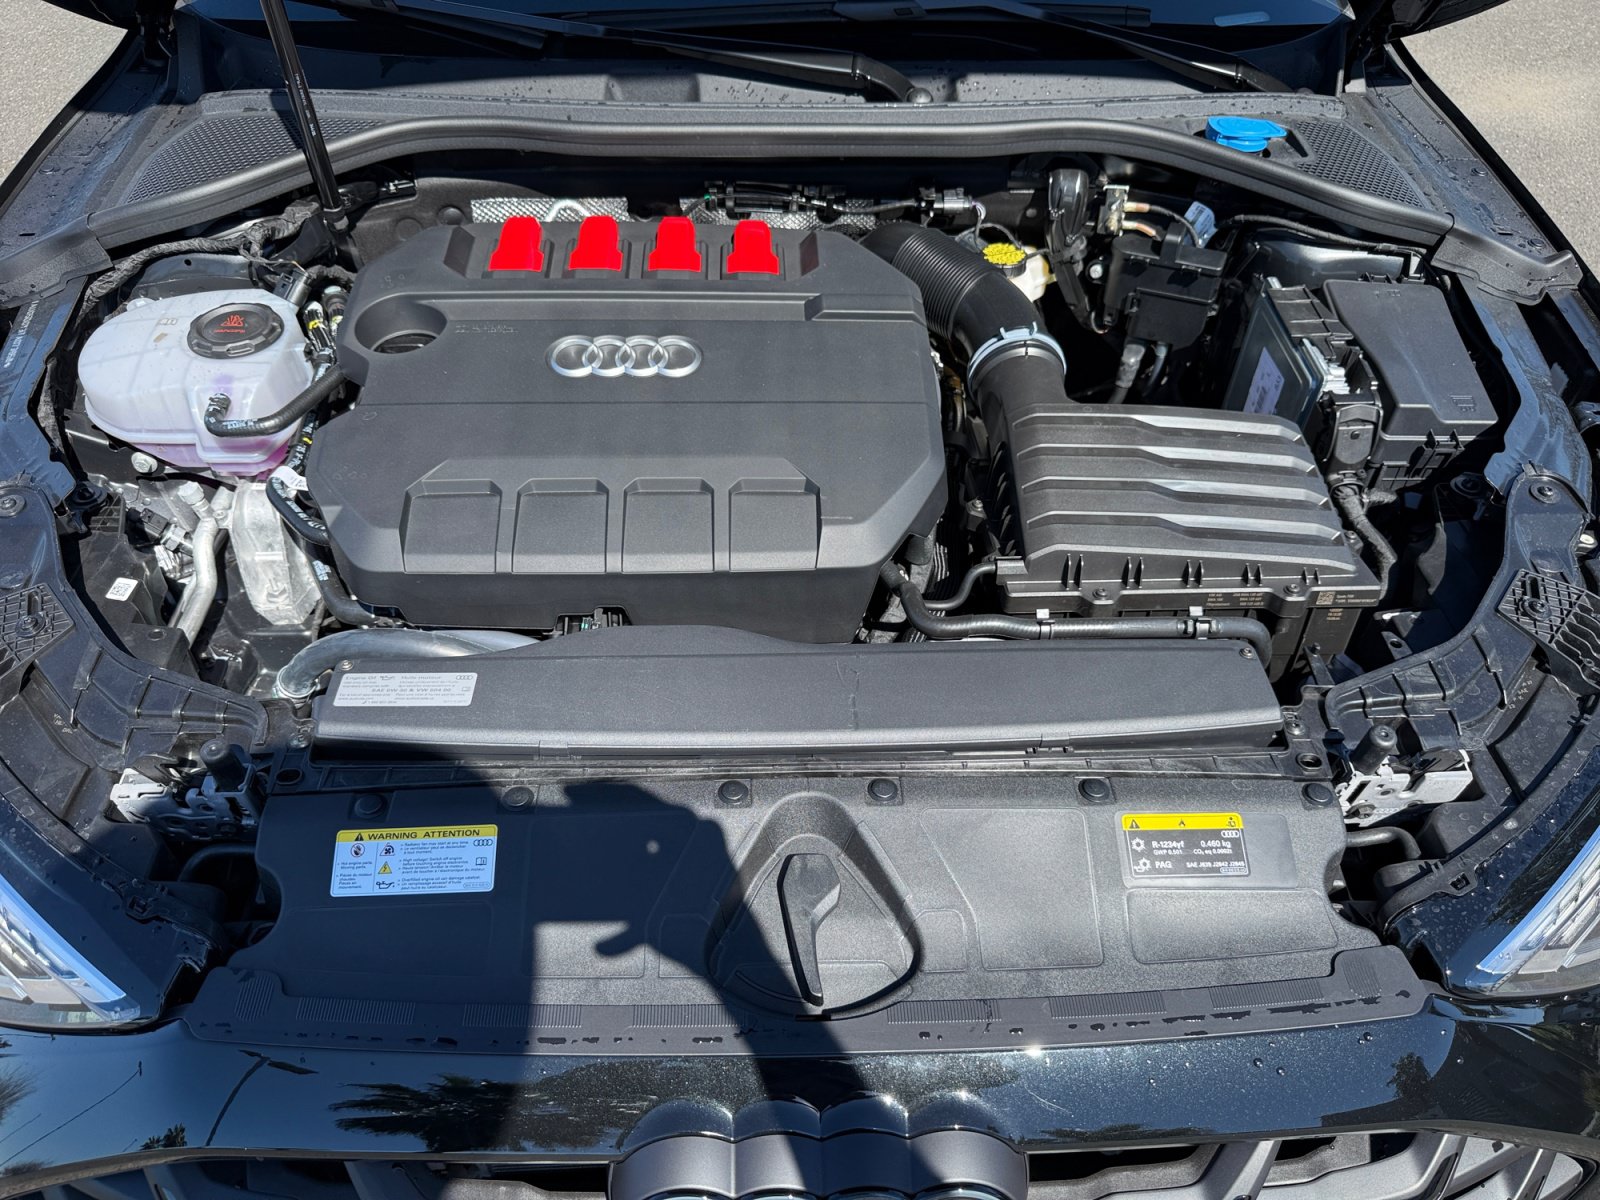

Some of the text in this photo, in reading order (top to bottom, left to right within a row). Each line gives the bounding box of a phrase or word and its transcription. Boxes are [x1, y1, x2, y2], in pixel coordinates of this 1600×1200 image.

[368, 830, 480, 840] WARNING ATTENTION
[1151, 840, 1185, 850] R-1234yf
[1221, 839, 1232, 849] kg
[1154, 860, 1173, 869] PAG
